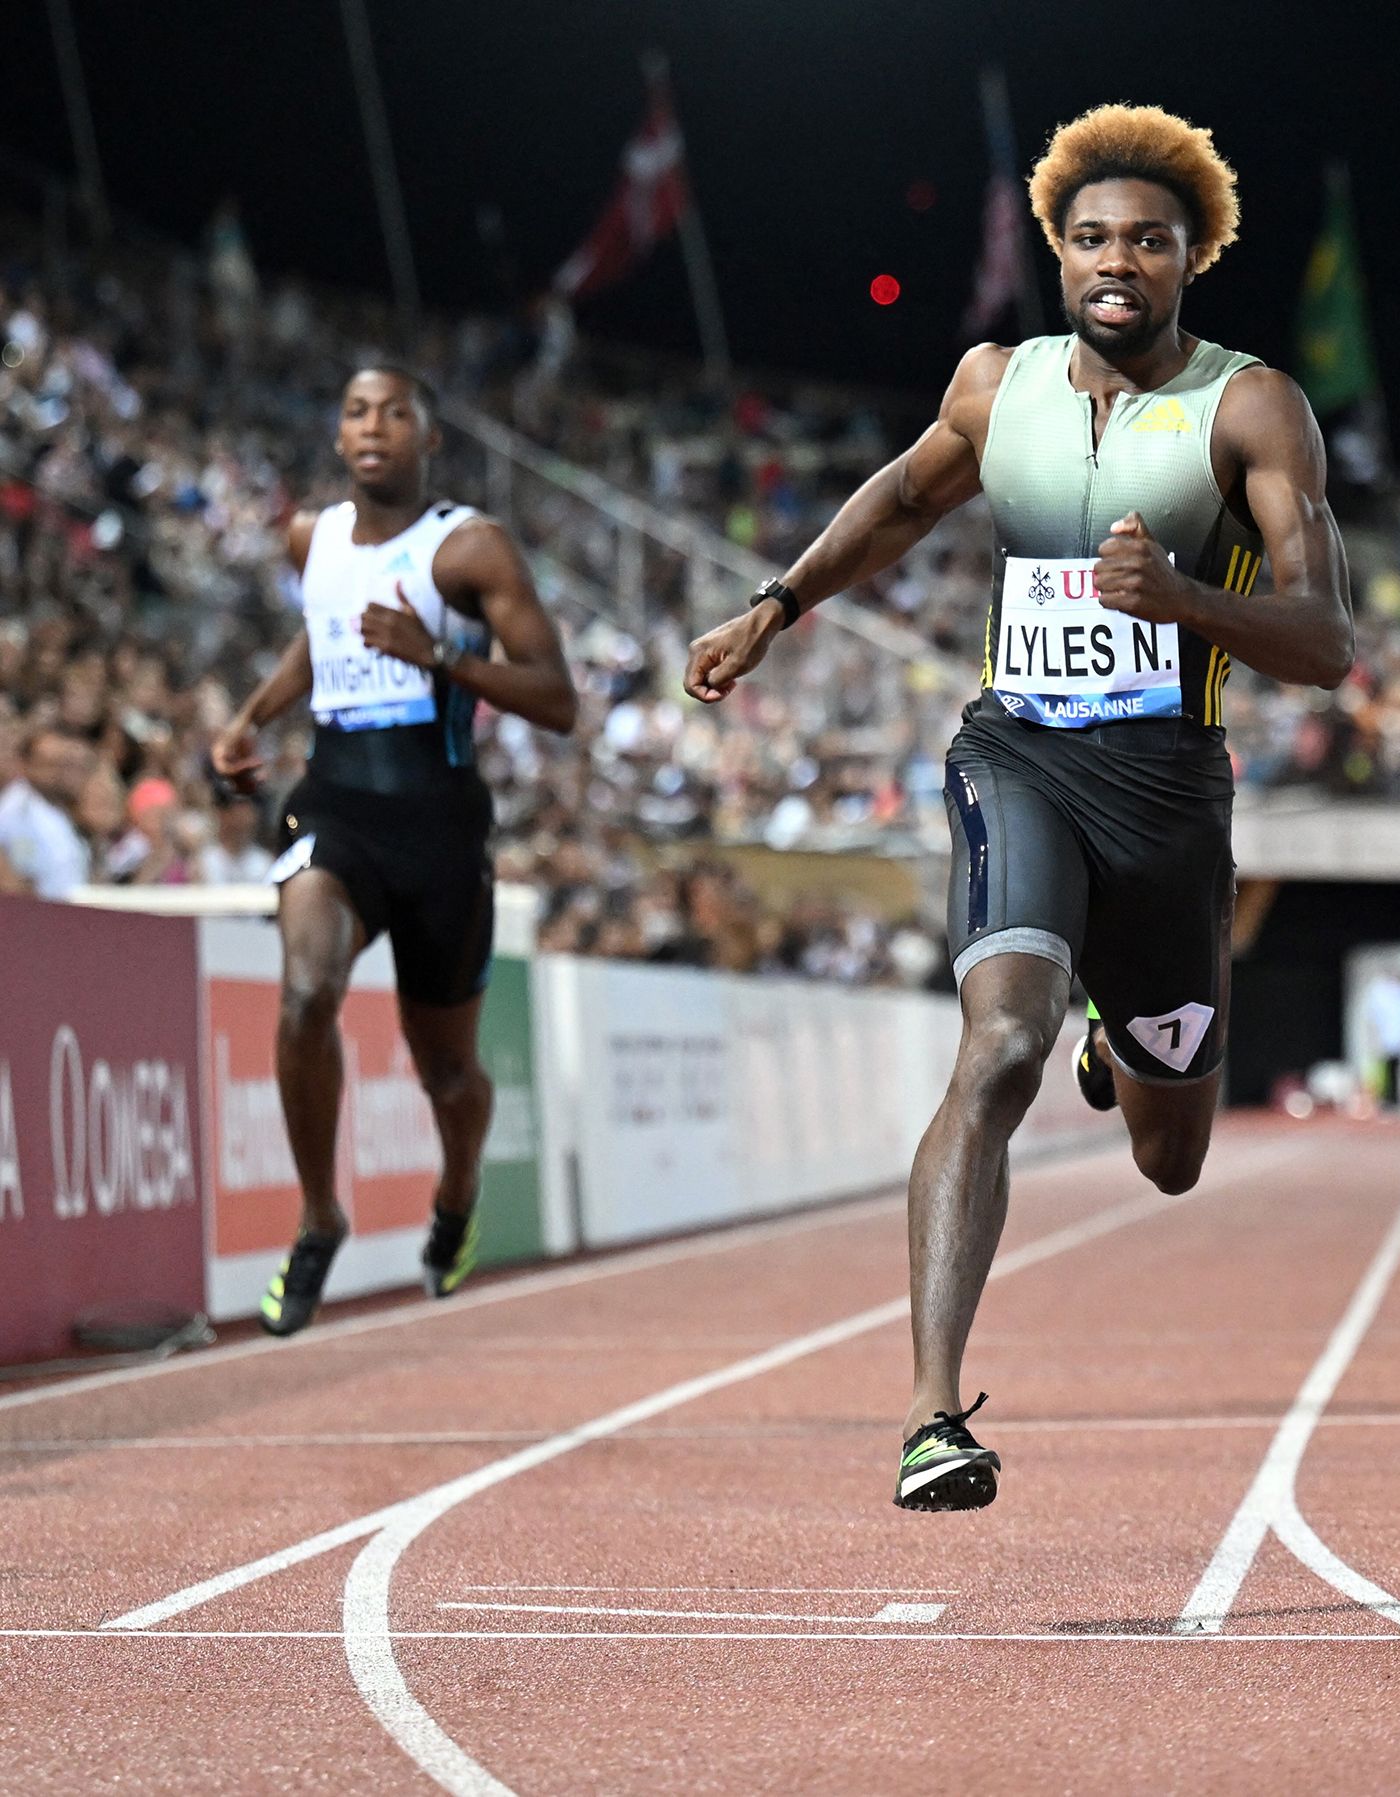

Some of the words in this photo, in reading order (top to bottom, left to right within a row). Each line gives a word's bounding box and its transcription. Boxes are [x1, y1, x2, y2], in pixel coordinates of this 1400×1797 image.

[1005, 624, 1115, 677] LYLES
[1132, 622, 1173, 673] N.
[1043, 697, 1144, 719] LAUSANNE
[1157, 1018, 1182, 1050] 7
